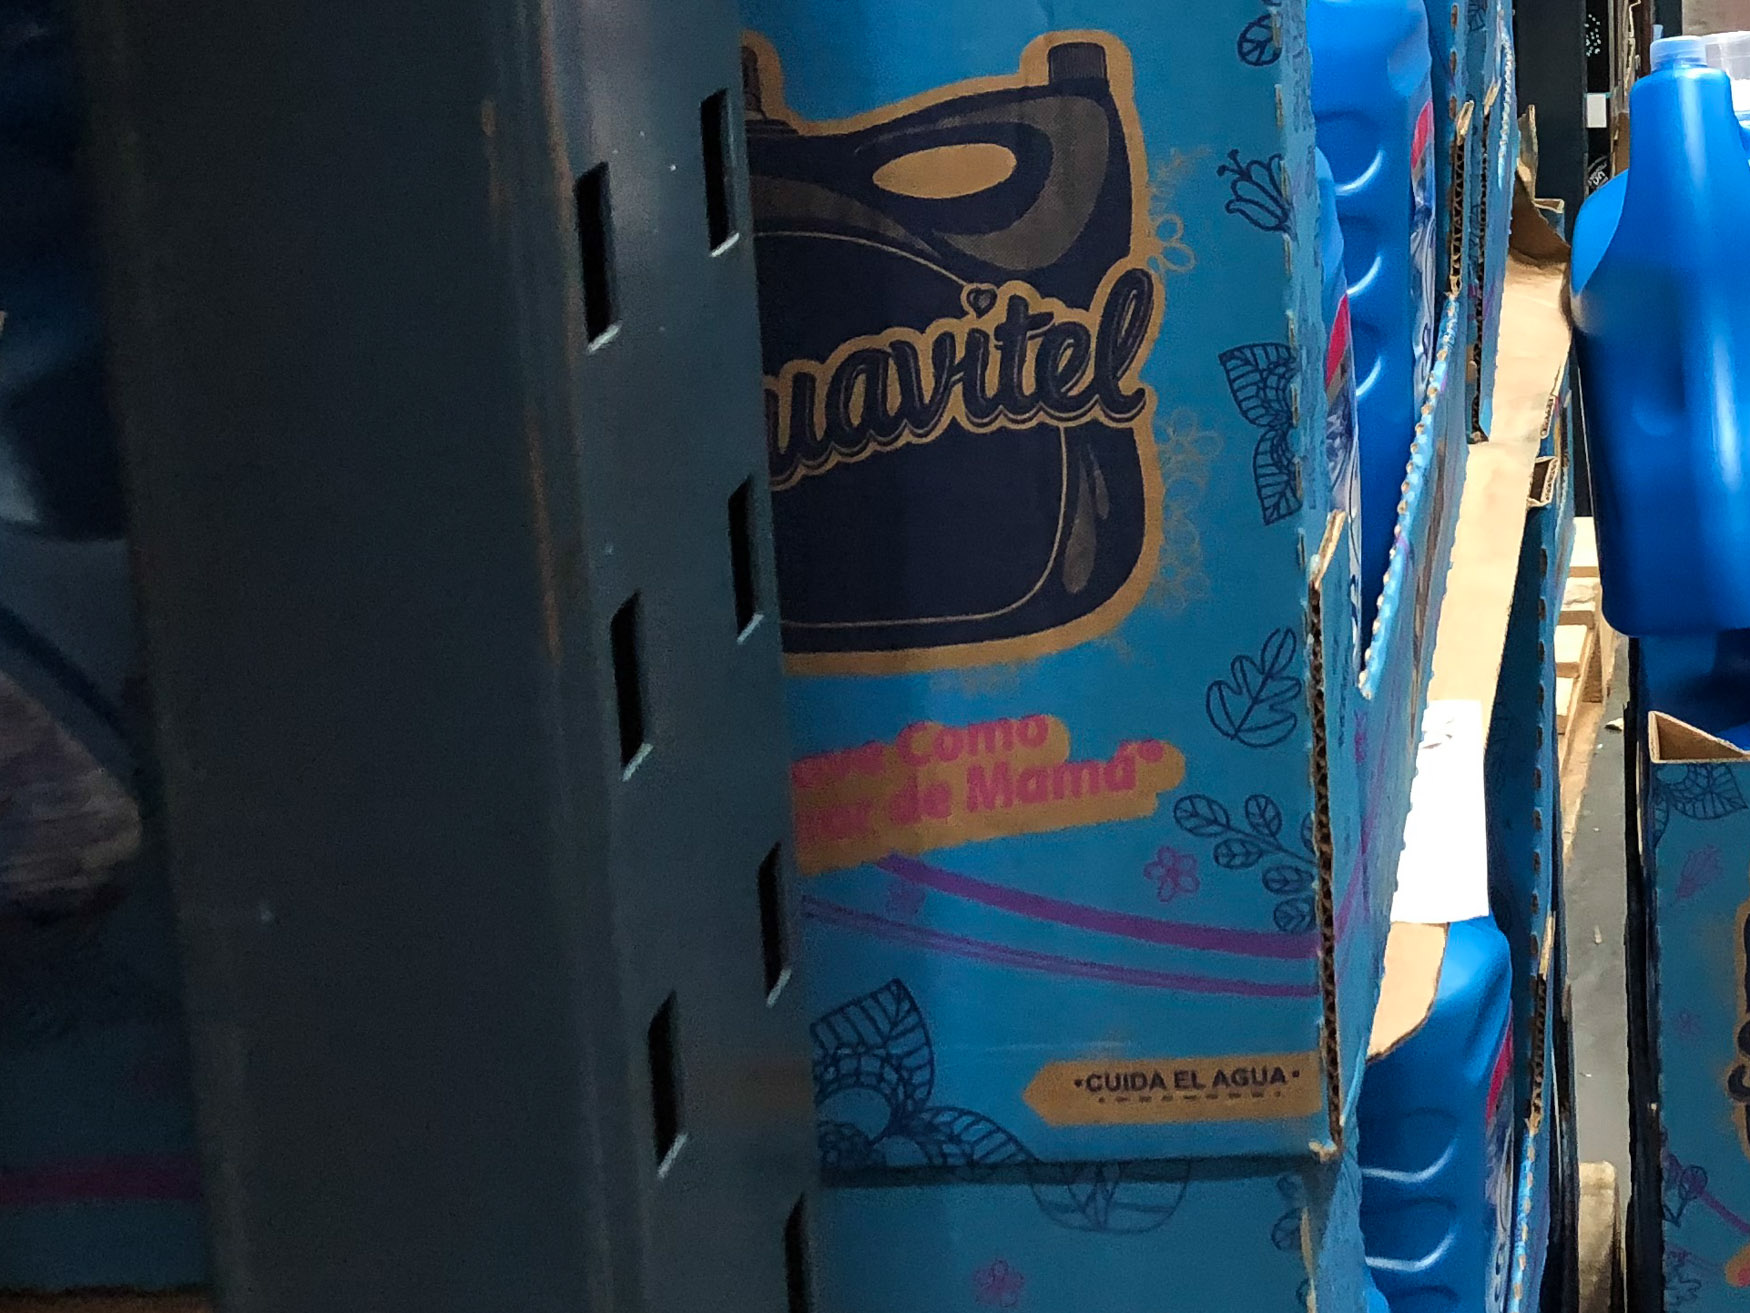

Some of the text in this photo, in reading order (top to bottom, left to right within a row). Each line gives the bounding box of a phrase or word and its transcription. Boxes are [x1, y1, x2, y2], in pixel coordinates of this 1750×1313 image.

[766, 268, 1155, 478] uavitel
[894, 713, 1049, 766] Como
[1086, 1066, 1287, 1093] CUIDA EL AGUA
